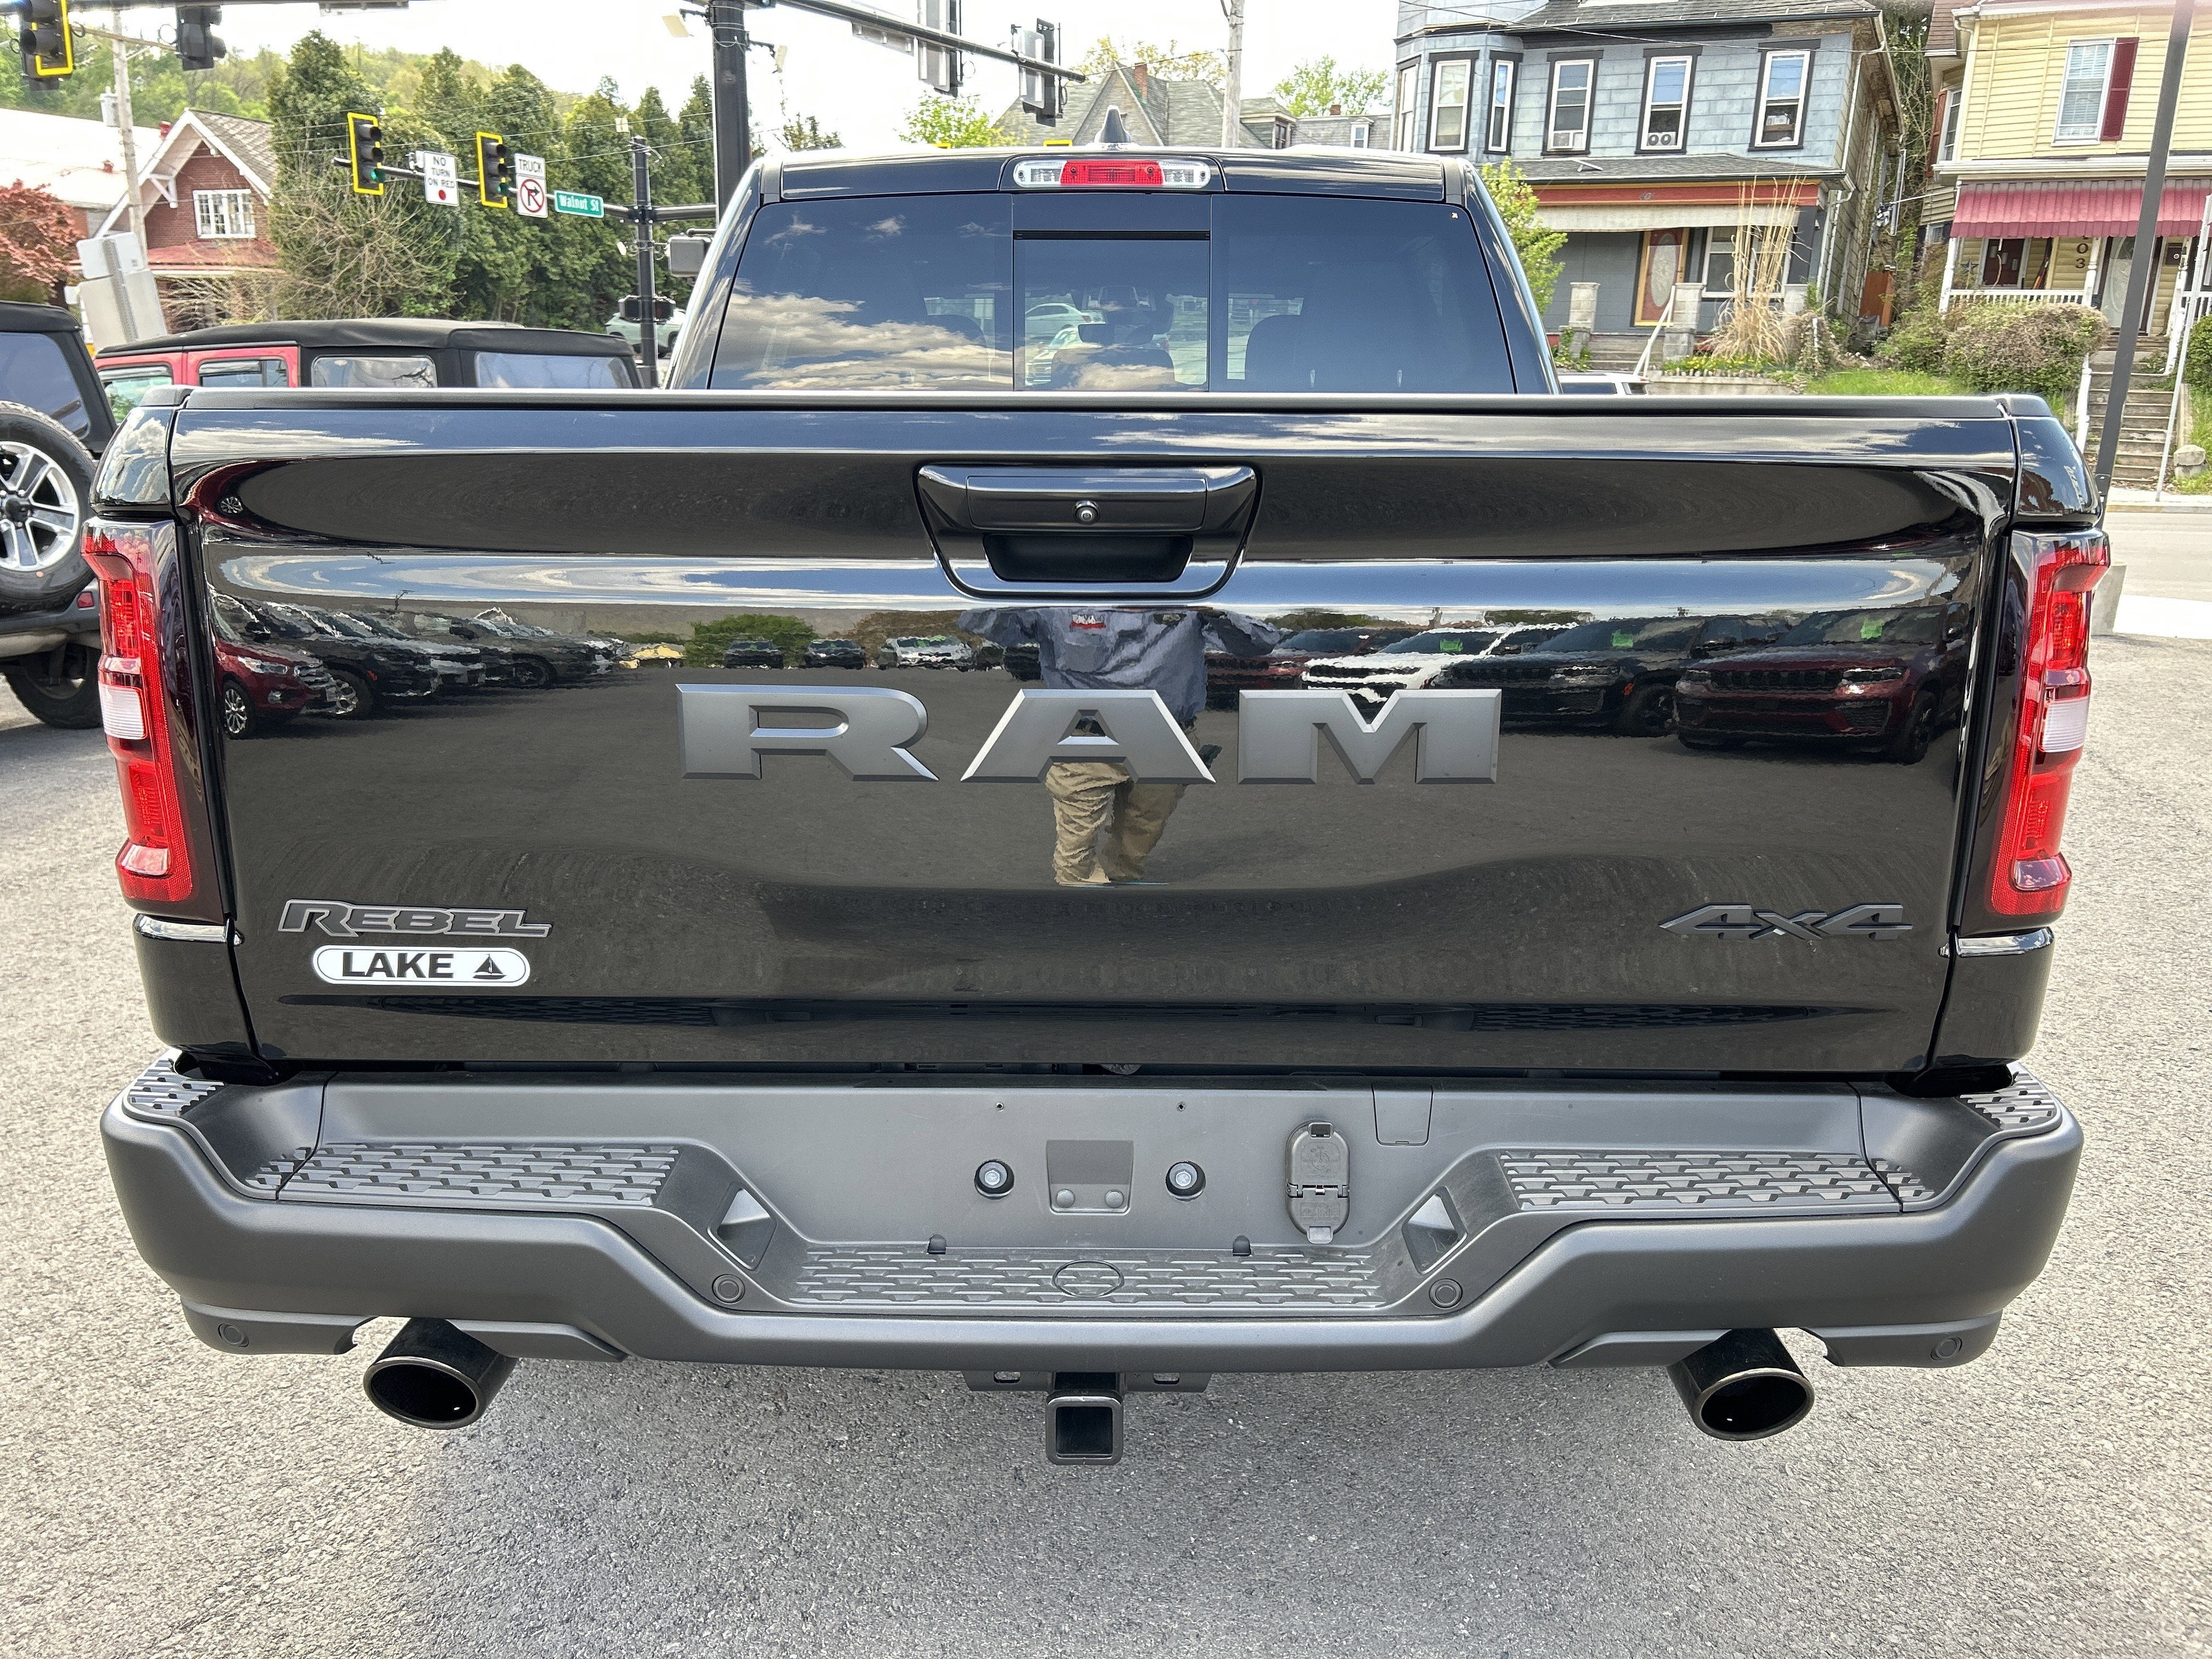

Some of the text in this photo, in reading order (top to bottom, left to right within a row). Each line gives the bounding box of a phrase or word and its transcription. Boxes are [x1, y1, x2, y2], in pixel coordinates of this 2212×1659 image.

[433, 156, 447, 166] NO
[518, 159, 542, 173] TRUCK
[431, 167, 451, 177] TURN
[428, 177, 455, 188] ON RED
[559, 194, 599, 212] Walnut St
[2075, 236, 2089, 268] 03
[676, 683, 1502, 785] RAM
[277, 899, 552, 938] REBEL
[342, 951, 454, 979] LAKE
